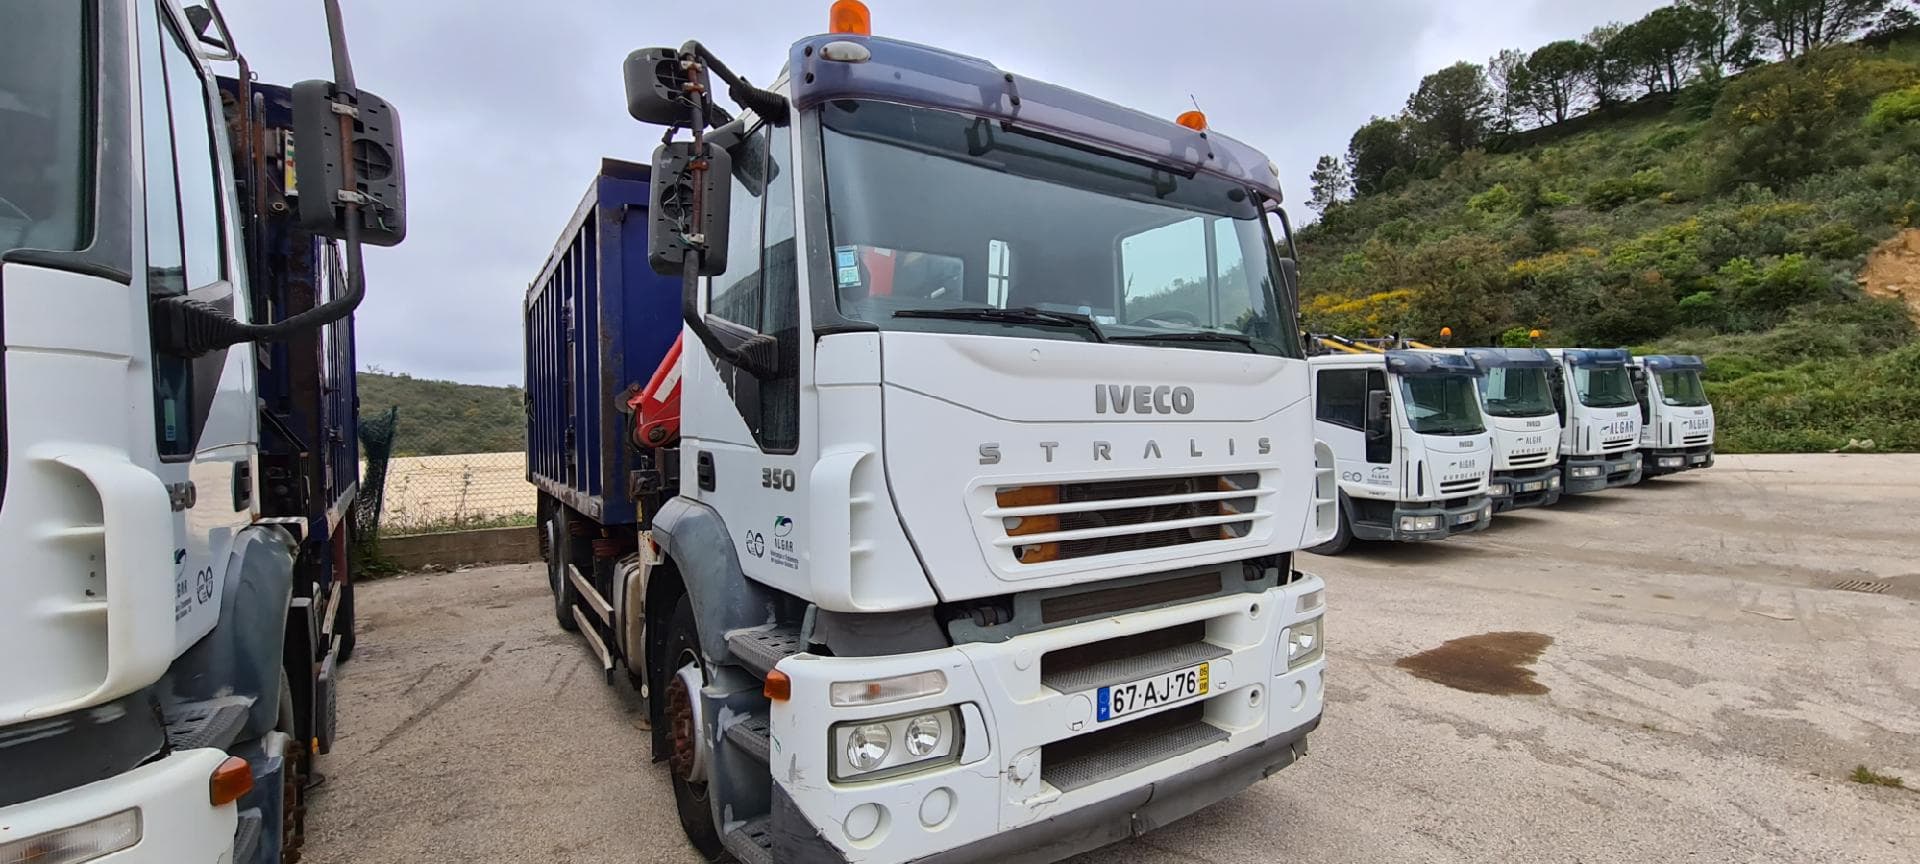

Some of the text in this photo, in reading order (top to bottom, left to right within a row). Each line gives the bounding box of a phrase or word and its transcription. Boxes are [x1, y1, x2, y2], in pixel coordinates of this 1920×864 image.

[1095, 383, 1195, 415] IVECO
[1610, 420, 1634, 434] ALGAR
[978, 437, 1272, 465] STRALIS
[762, 467, 795, 492] 350
